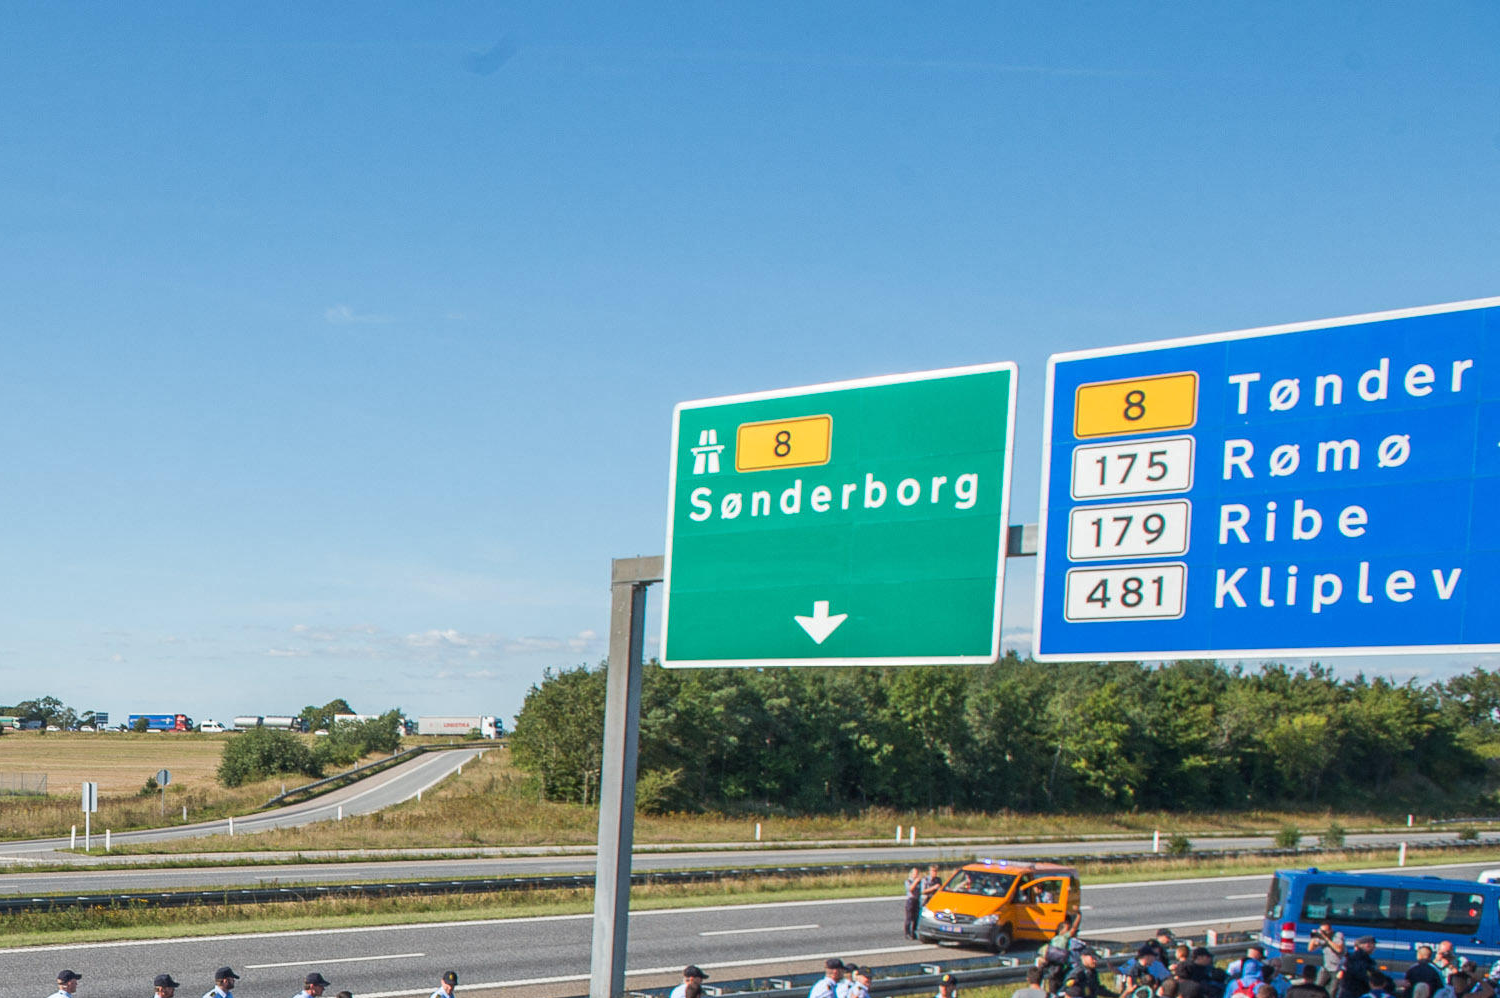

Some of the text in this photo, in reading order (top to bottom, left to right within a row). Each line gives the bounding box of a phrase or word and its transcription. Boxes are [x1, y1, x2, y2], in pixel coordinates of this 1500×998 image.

[1124, 357, 1474, 421] 8 Tønder
[774, 430, 791, 457] 8
[1096, 434, 1411, 486] 175 Rømø
[689, 470, 980, 522] Sønderborg
[1091, 499, 1369, 548] 179 Ribe
[1086, 561, 1463, 614] 481 Kliplev
